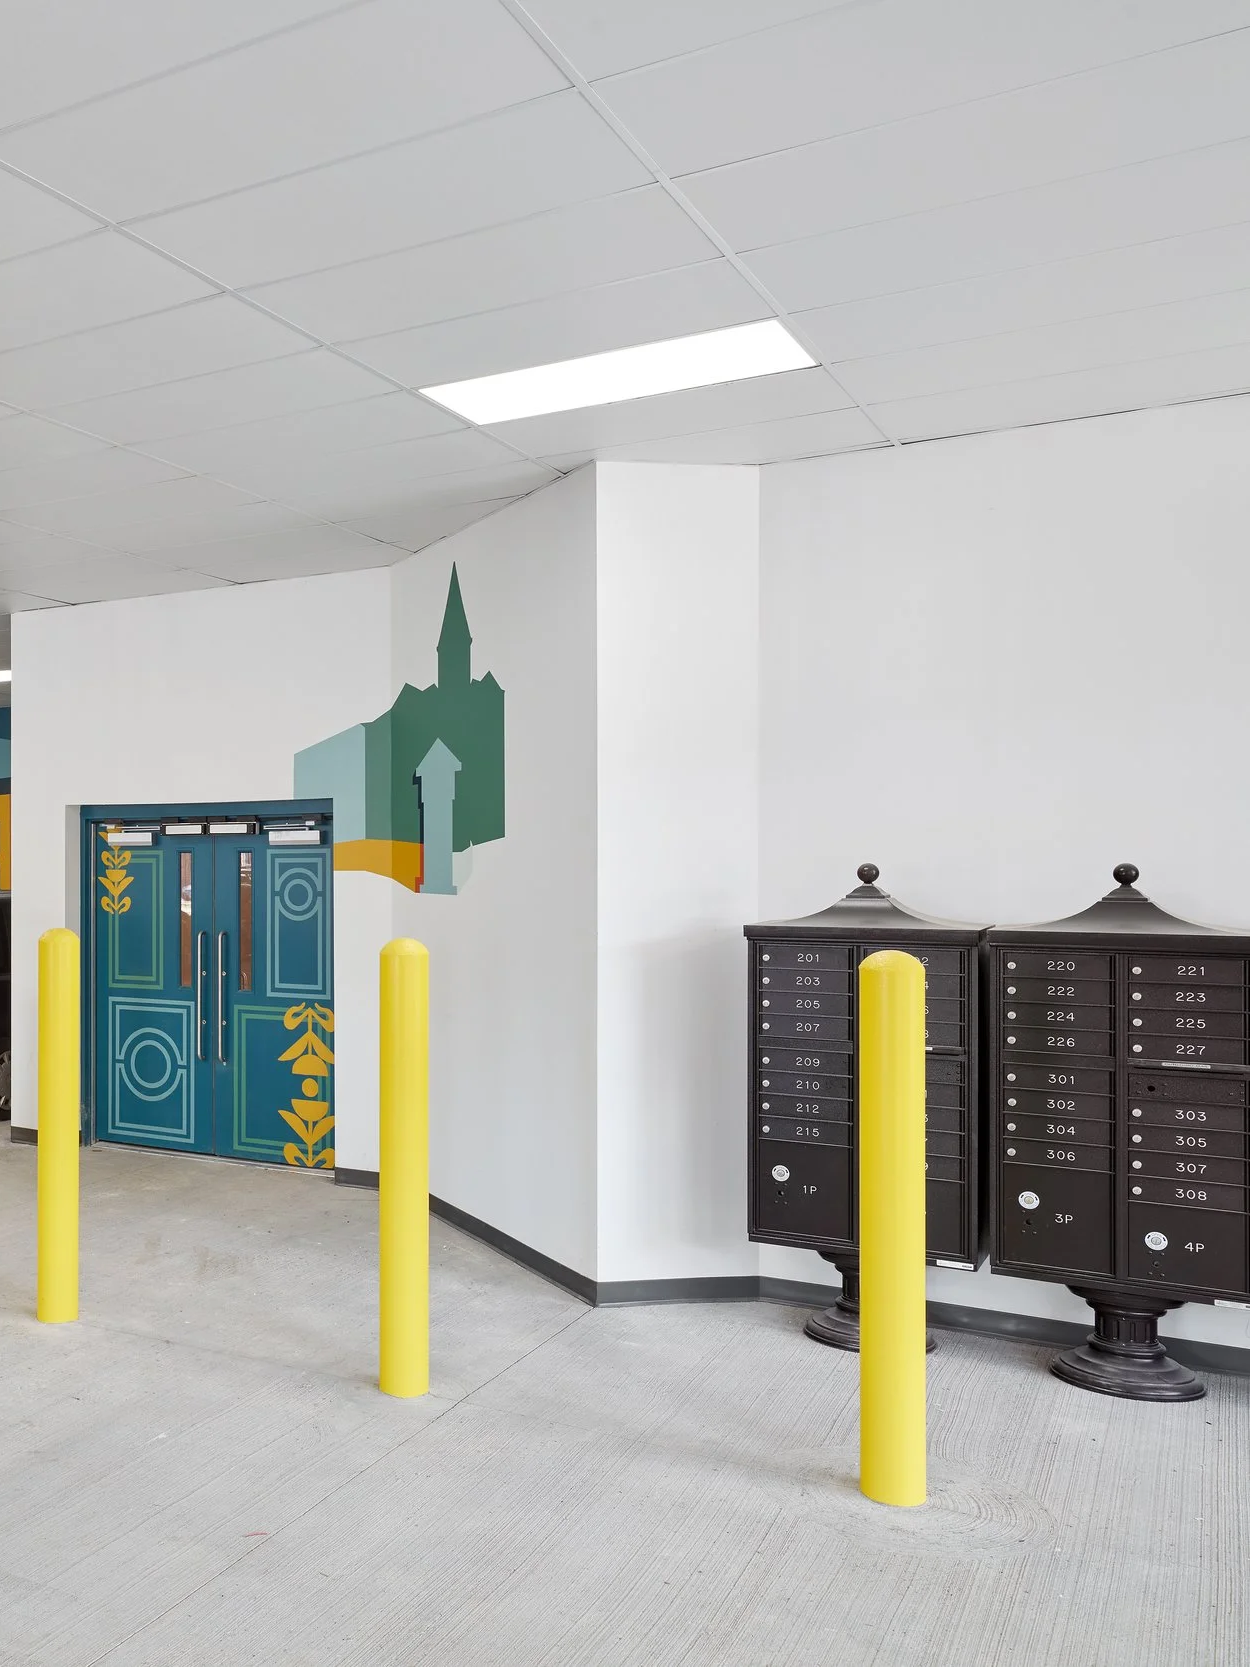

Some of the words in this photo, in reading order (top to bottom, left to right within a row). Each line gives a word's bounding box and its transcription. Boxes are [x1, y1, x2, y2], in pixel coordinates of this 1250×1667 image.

[797, 952, 820, 963] 201
[1046, 960, 1076, 971] 220
[1176, 964, 1206, 977] 221
[795, 975, 821, 987] 203
[1046, 985, 1076, 997] 222
[1175, 991, 1207, 1003] 223
[795, 999, 821, 1010] 205
[1046, 1010, 1076, 1022] 224
[795, 1021, 821, 1033] 207
[1175, 1017, 1207, 1029] 225
[1046, 1035, 1076, 1048] 226
[1175, 1043, 1207, 1056] 227
[795, 1056, 821, 1068] 209
[795, 1079, 821, 1091] 210
[1047, 1073, 1076, 1085] 301
[795, 1102, 821, 1114] 212
[1046, 1098, 1076, 1111] 302
[1174, 1109, 1207, 1122] 303
[795, 1126, 821, 1138] 215
[1046, 1124, 1076, 1136] 304
[1174, 1135, 1207, 1148] 305
[1046, 1149, 1076, 1162] 306
[1174, 1161, 1207, 1175] 307
[802, 1185, 818, 1195] 1P
[1174, 1187, 1207, 1201] 308
[1054, 1213, 1074, 1225] 3P
[1183, 1241, 1206, 1254] 4P
